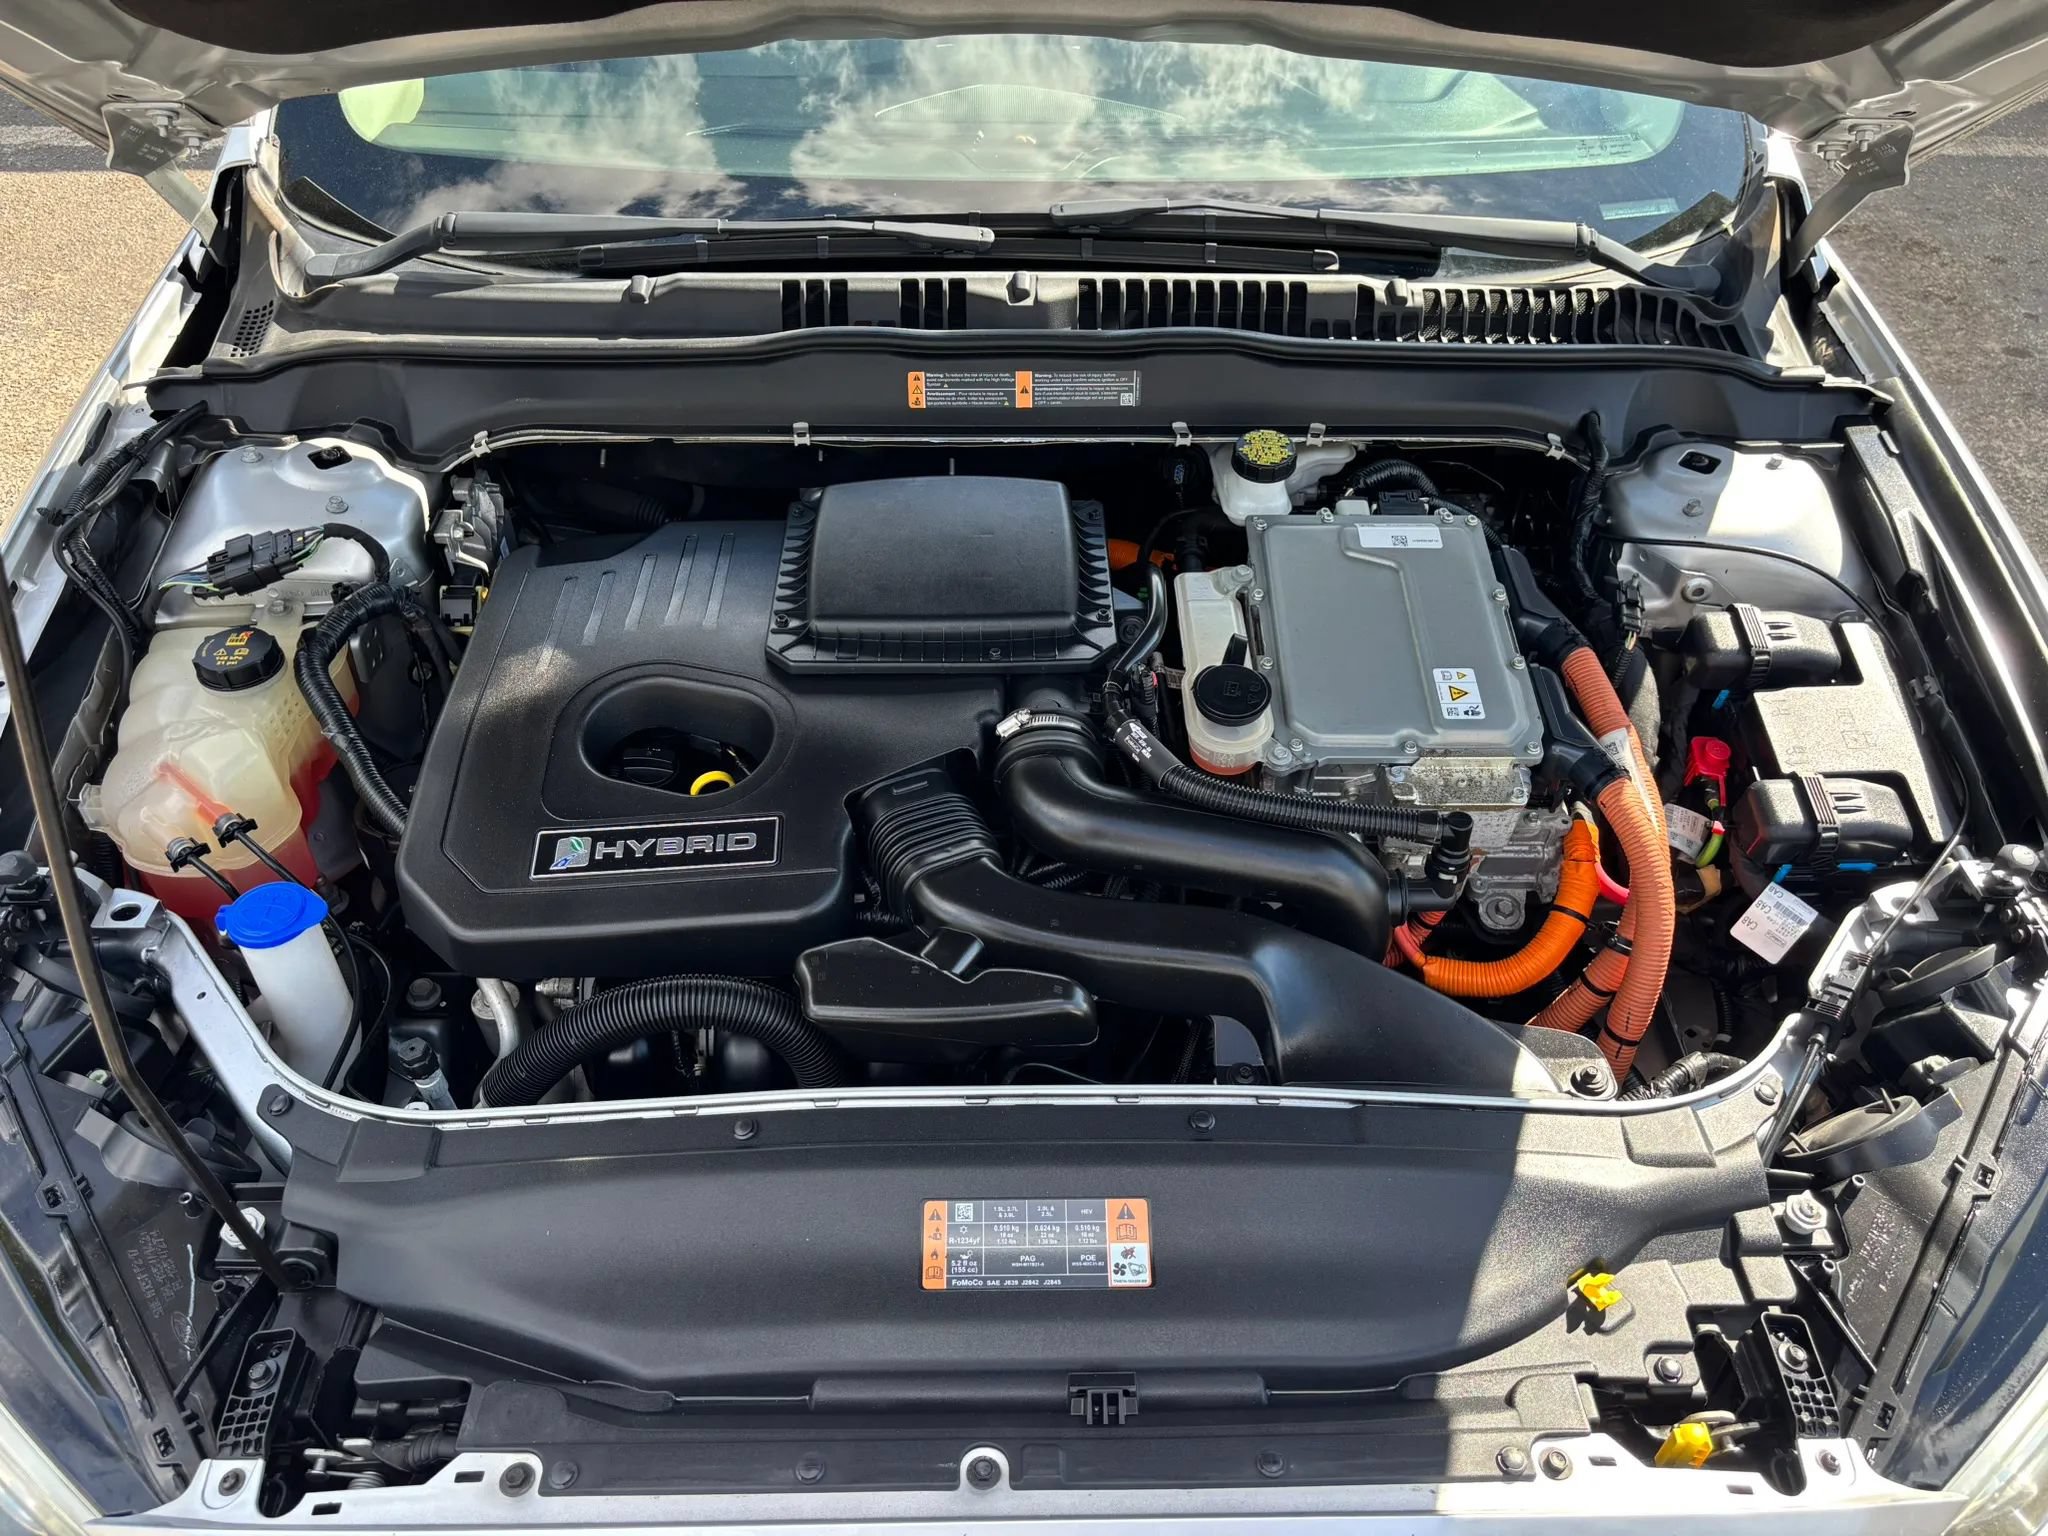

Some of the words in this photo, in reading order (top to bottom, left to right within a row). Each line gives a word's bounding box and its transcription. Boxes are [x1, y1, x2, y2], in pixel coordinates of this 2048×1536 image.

[595, 832, 758, 859] HYBRID
[1768, 886, 1784, 898] CAB
[1754, 900, 1772, 914] CAB
[1741, 916, 1758, 930] CAB
[948, 1237, 980, 1245] R-1234yf
